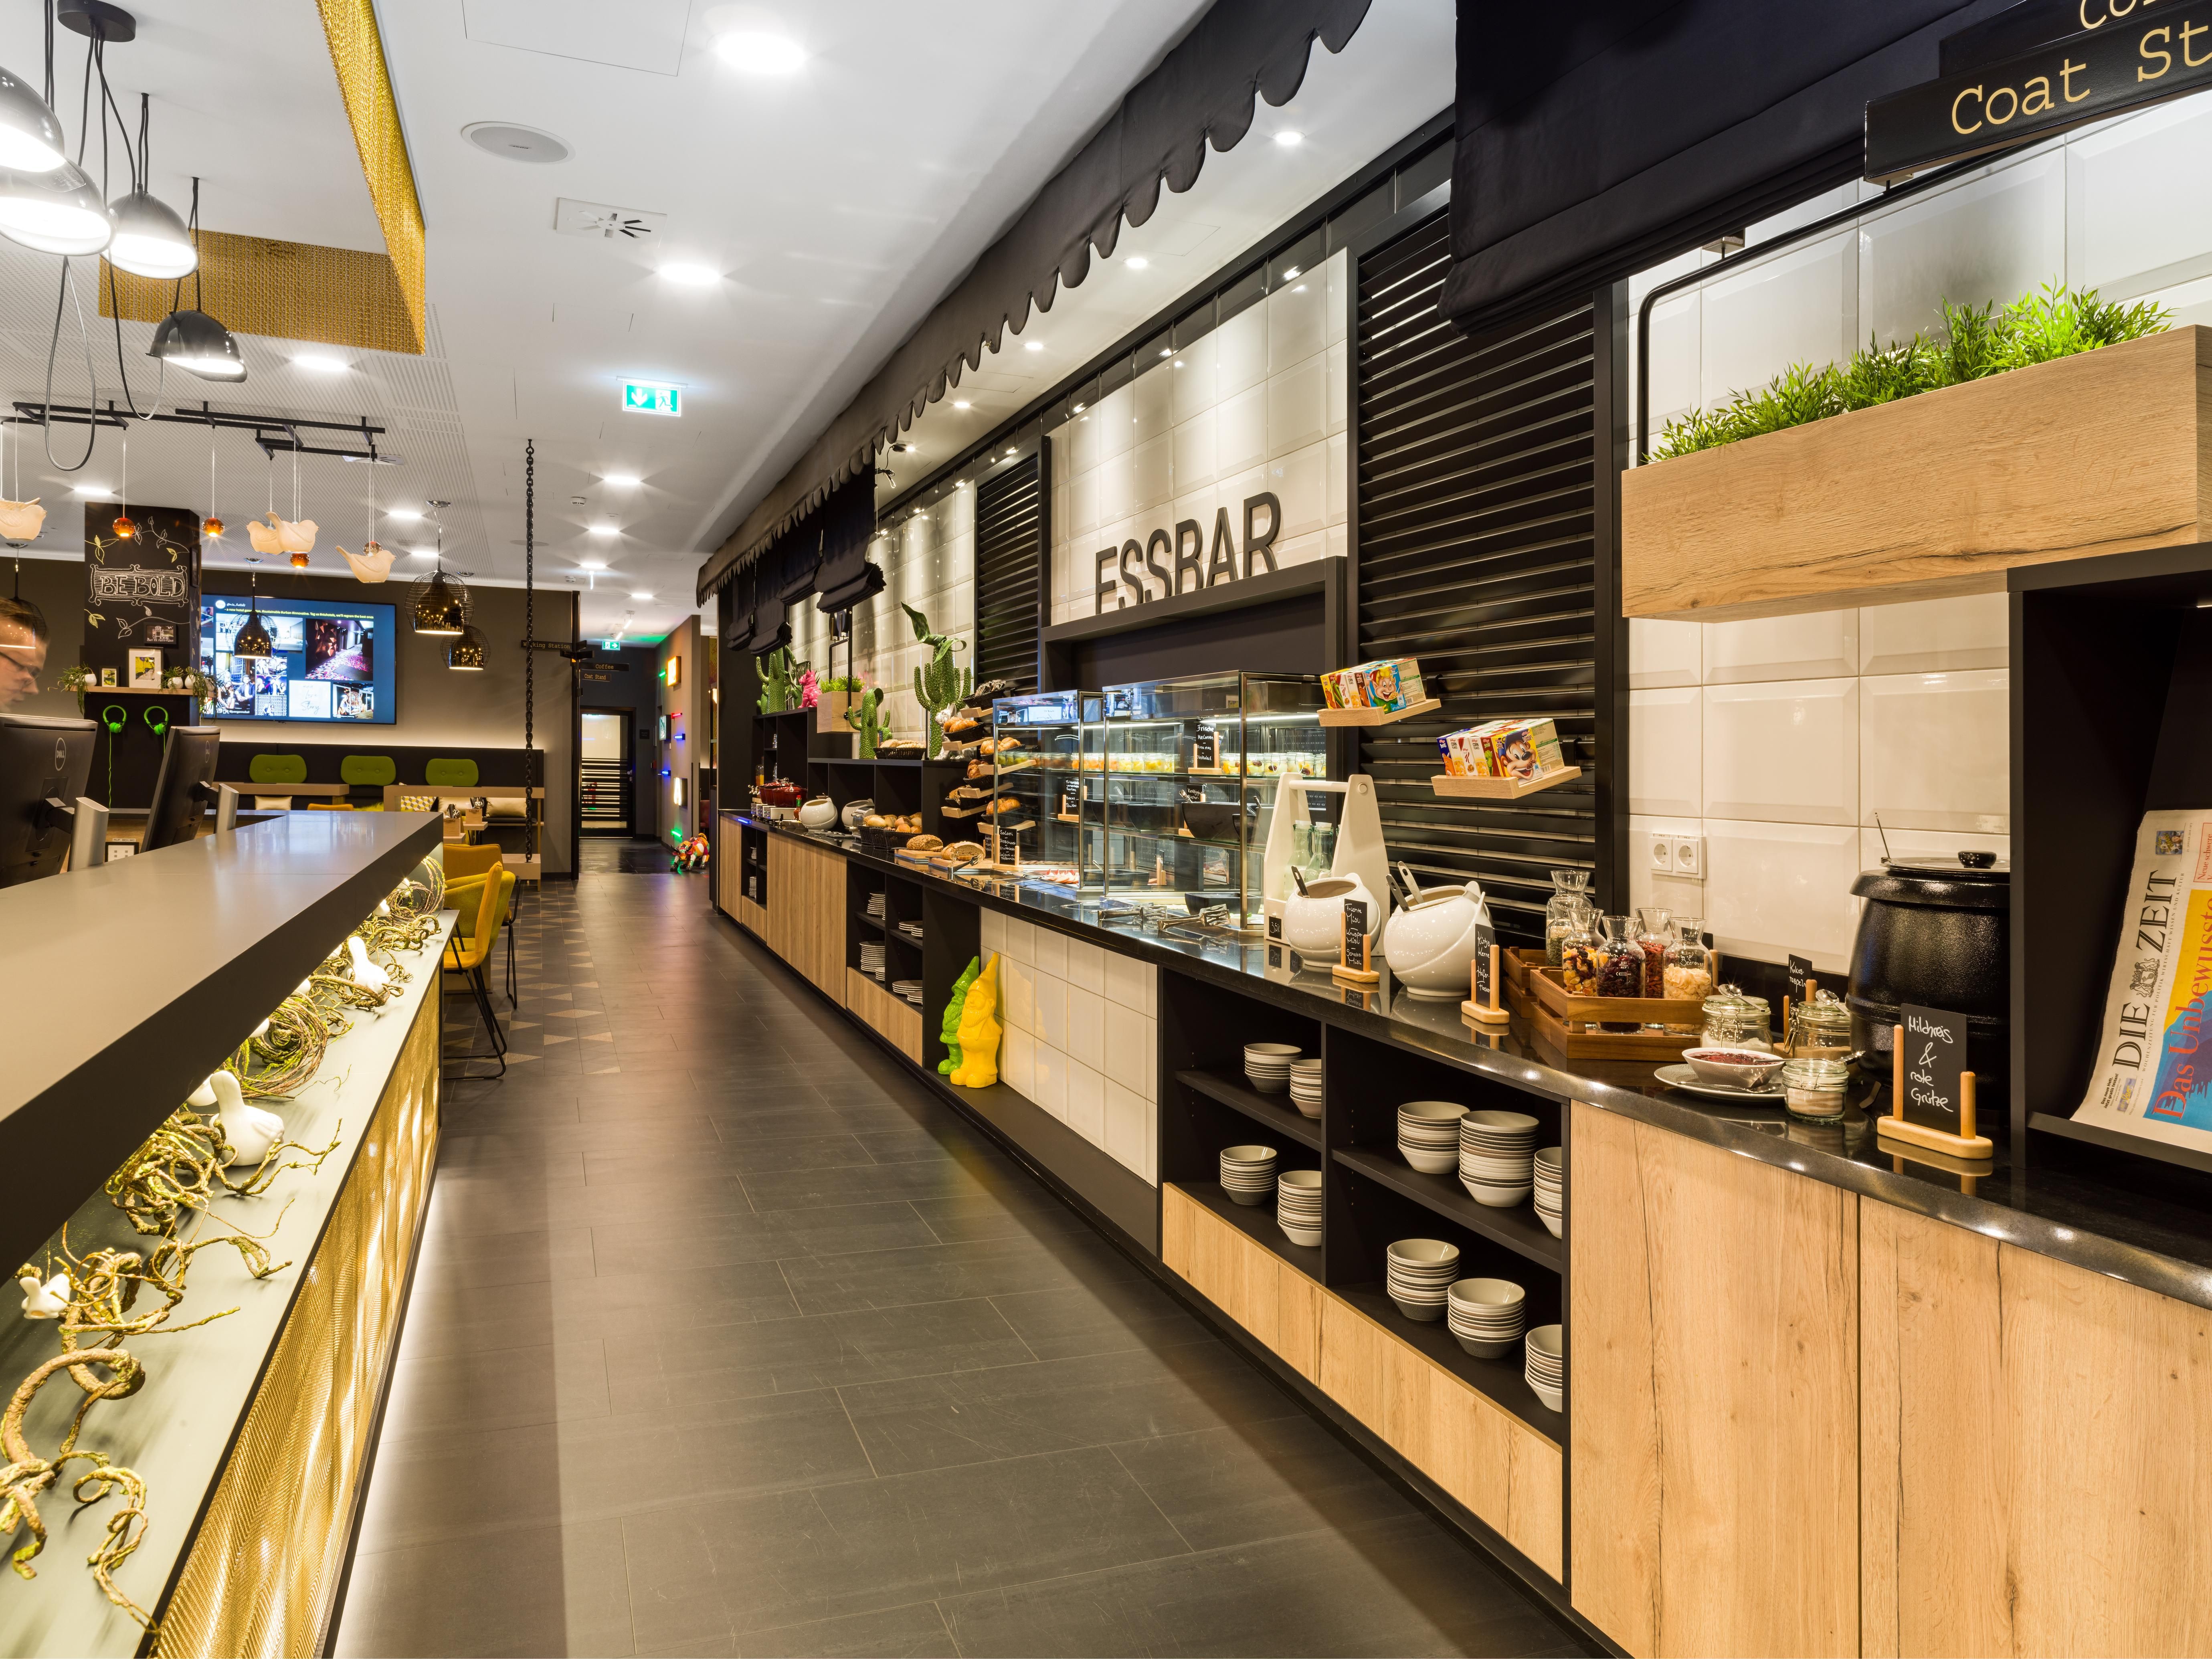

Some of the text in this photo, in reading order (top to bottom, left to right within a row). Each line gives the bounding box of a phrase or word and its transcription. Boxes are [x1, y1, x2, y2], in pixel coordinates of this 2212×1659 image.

[1951, 58, 2091, 135] Coat
[1095, 491, 1281, 614] ESSBAR
[99, 575, 184, 597] BE BOLD
[1196, 724, 1214, 732] Frische
[2197, 862, 2209, 880] Neue
[1345, 903, 1362, 913] Früchte
[1346, 913, 1361, 924] Müsli
[1477, 931, 1490, 948] Kürbis
[1348, 956, 1362, 965] Müsli
[1478, 947, 1490, 958] Kerne
[2112, 869, 2177, 1071] DIE ZEIT
[2142, 1018, 2154, 1072] WOCHENZEITUNG
[2155, 978, 2164, 1002] POLITIK
[2161, 938, 2172, 975] WIRTSCHAFT
[2176, 873, 2184, 895] KULTUR
[2152, 897, 2212, 1120] Das Unbewusst
[1909, 1015, 1953, 1043] Milchreis
[1919, 1042, 1937, 1068] &
[1910, 1069, 1934, 1087] rote
[1911, 1087, 1953, 1112] Grütze
